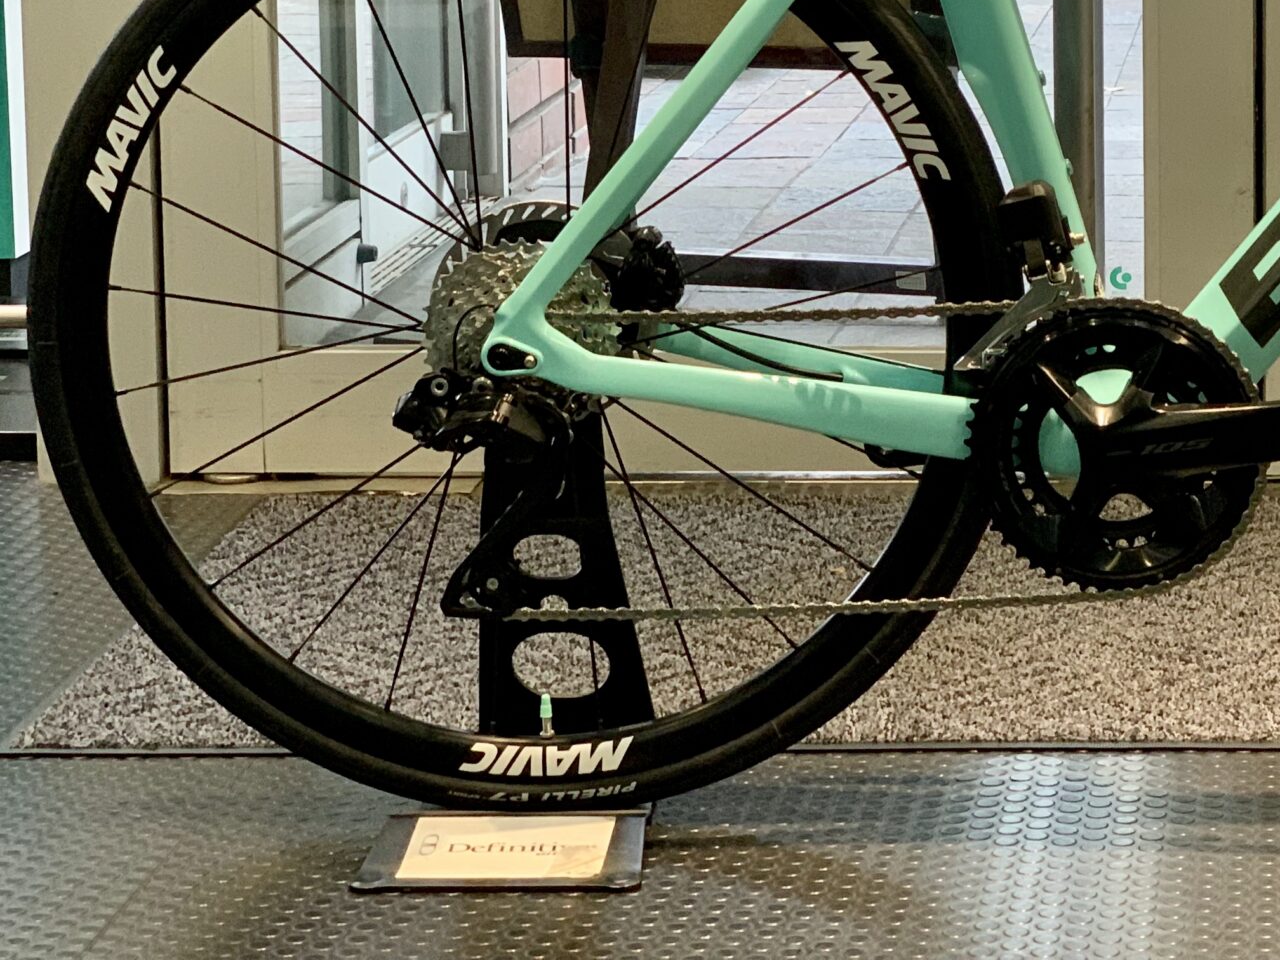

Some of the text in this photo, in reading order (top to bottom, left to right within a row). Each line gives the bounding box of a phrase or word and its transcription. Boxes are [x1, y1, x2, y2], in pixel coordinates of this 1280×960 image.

[86, 44, 177, 213] MAVIC
[833, 41, 951, 180] MAVIC
[458, 735, 634, 777] MAVIC
[488, 792, 529, 802] P7
[541, 781, 637, 802] PIRELLI
